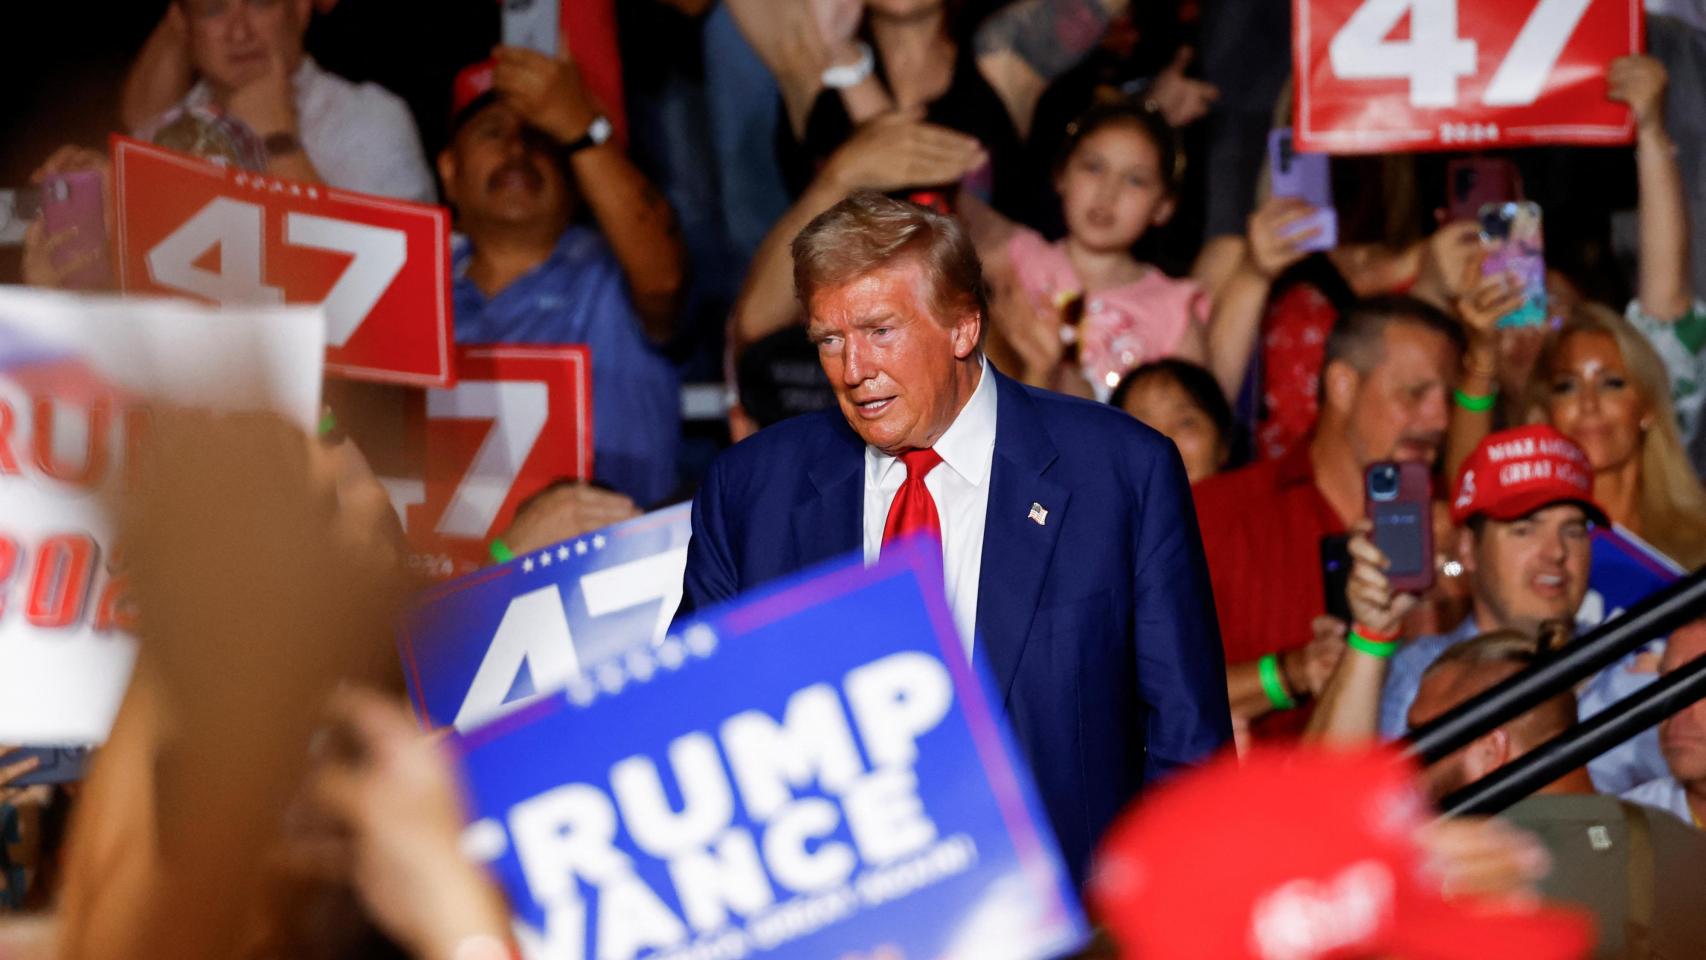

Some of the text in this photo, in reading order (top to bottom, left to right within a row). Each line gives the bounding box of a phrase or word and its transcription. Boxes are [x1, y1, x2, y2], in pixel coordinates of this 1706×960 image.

[1329, 0, 1592, 108] 47
[145, 196, 408, 347] 47
[460, 651, 954, 904] RUMP
